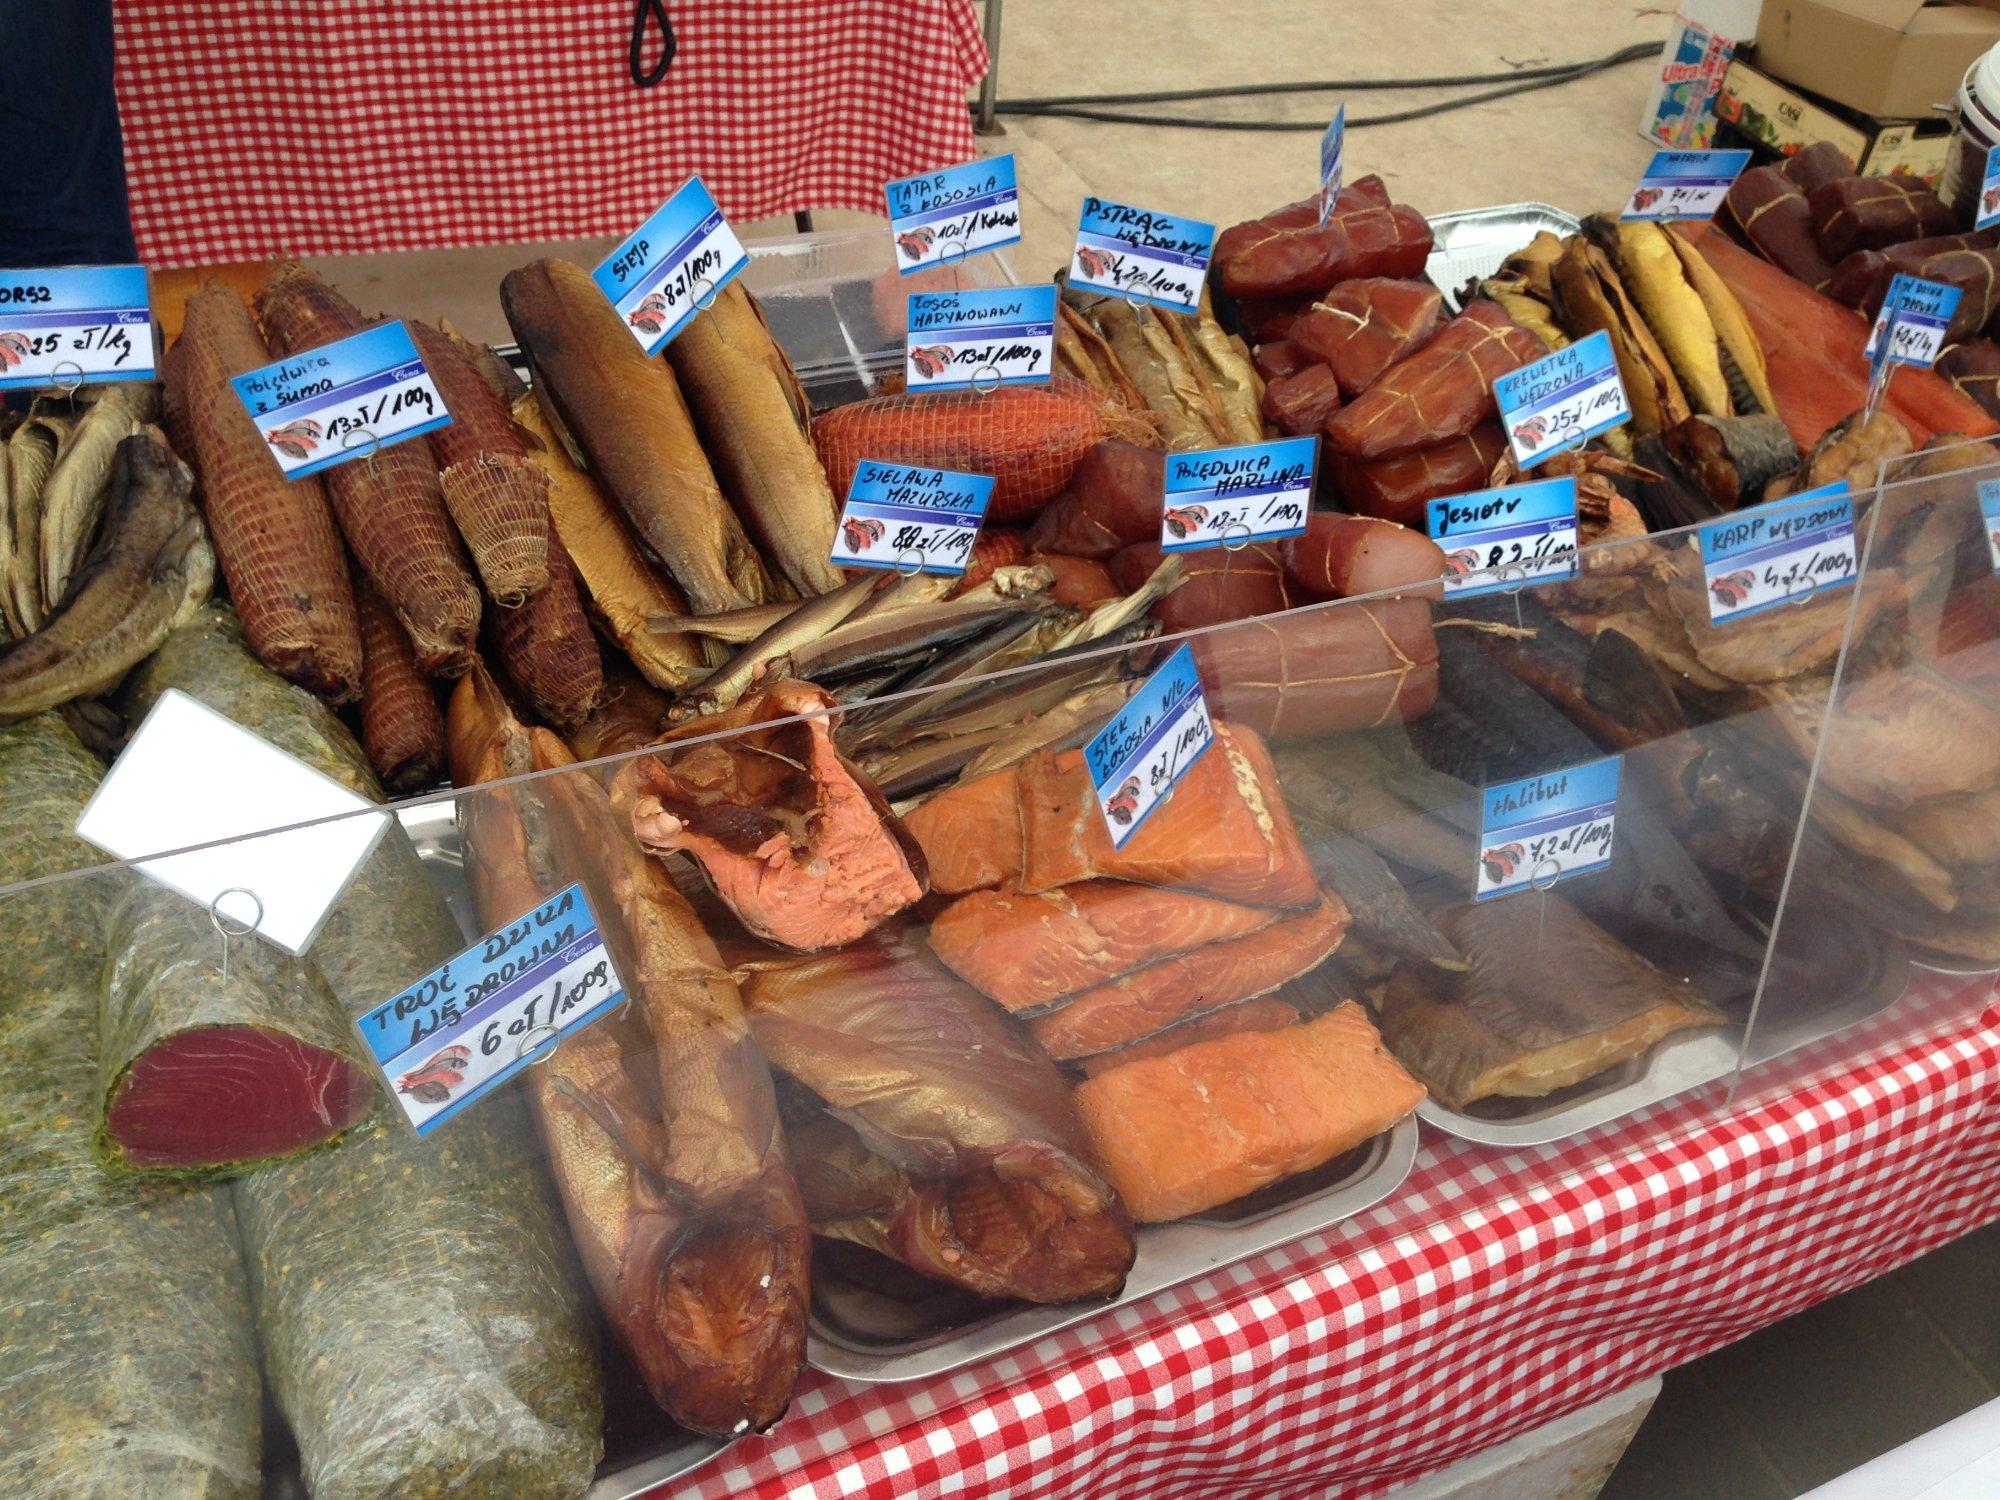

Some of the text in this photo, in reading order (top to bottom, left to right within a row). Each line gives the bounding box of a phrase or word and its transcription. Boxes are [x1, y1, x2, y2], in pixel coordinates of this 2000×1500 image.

[891, 175, 946, 204] TATAR
[117, 313, 144, 323] Cena
[1026, 327, 1048, 336] Cena
[392, 368, 419, 382] Cena
[862, 468, 943, 488] SIELAWA
[886, 487, 974, 509] MAZURSKA
[1712, 518, 1765, 551] KARP
[1094, 716, 1128, 766] STEK
[560, 942, 594, 964] Cena
